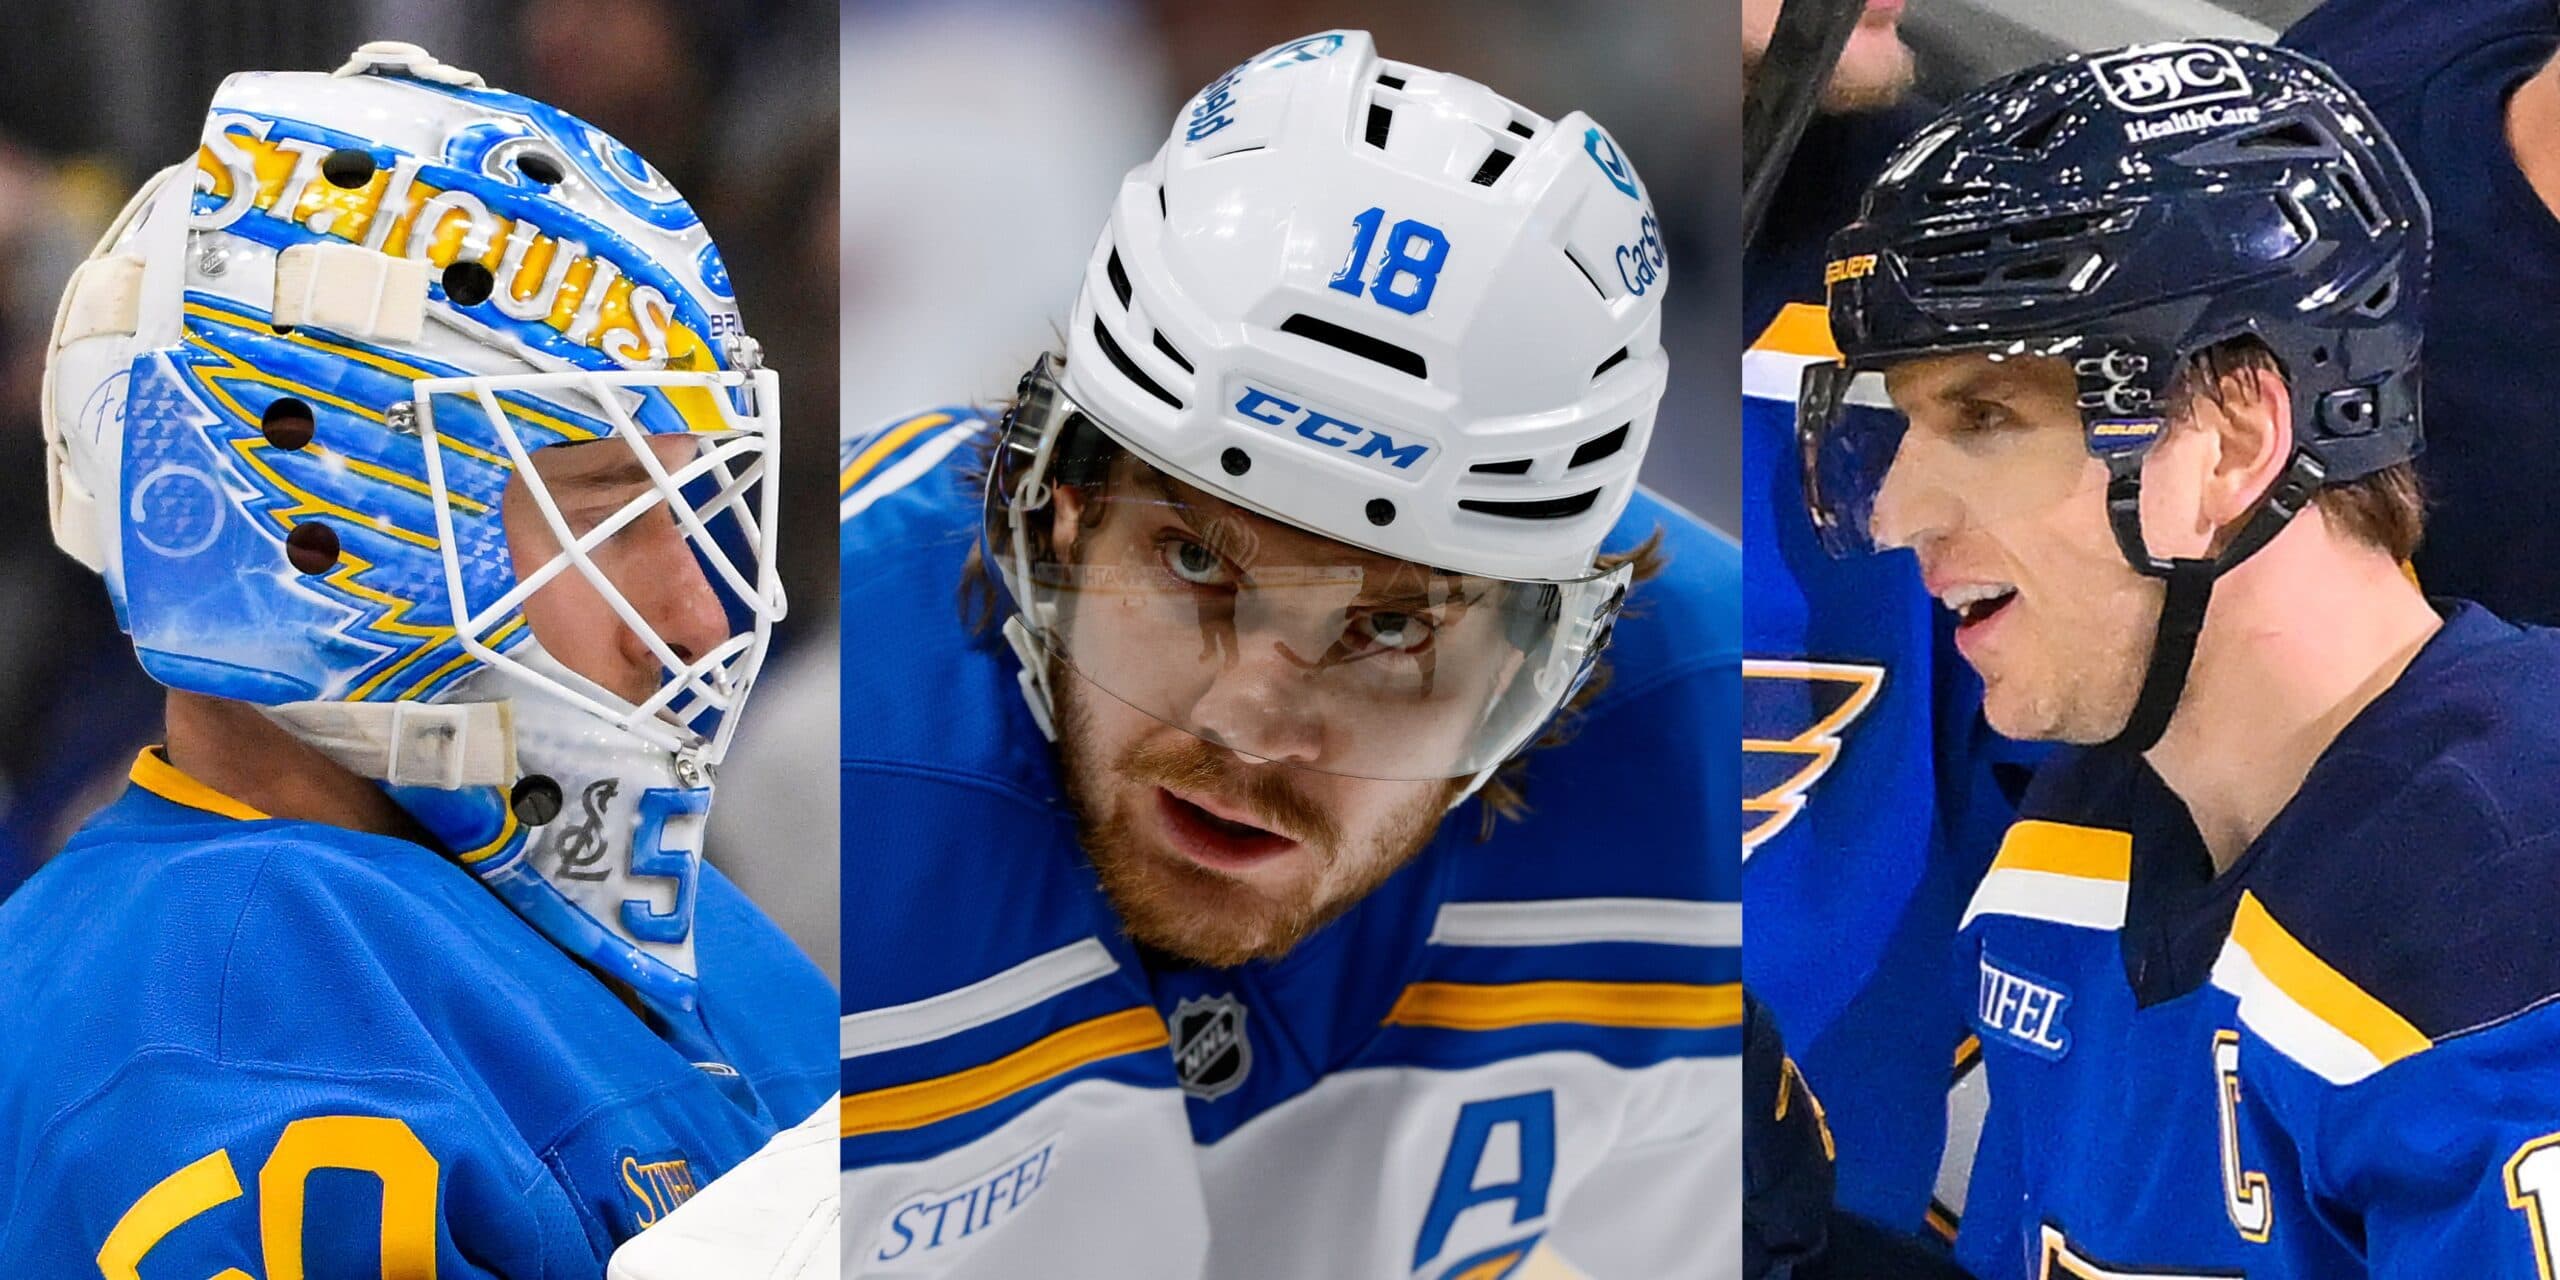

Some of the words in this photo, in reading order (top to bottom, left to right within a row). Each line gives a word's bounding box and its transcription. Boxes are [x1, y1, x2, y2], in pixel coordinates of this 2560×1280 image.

[1186, 60, 1250, 141] hield
[2114, 51, 2227, 100] BJC
[2123, 105, 2260, 143] HealthCare
[1328, 206, 1450, 315] 18
[711, 313, 744, 337] BR
[1235, 386, 1429, 469] CCM
[1979, 960, 2065, 1051] TIFEL
[1184, 1019, 1231, 1077] NHL
[2212, 1029, 2273, 1243] C
[1411, 1087, 1556, 1275] A
